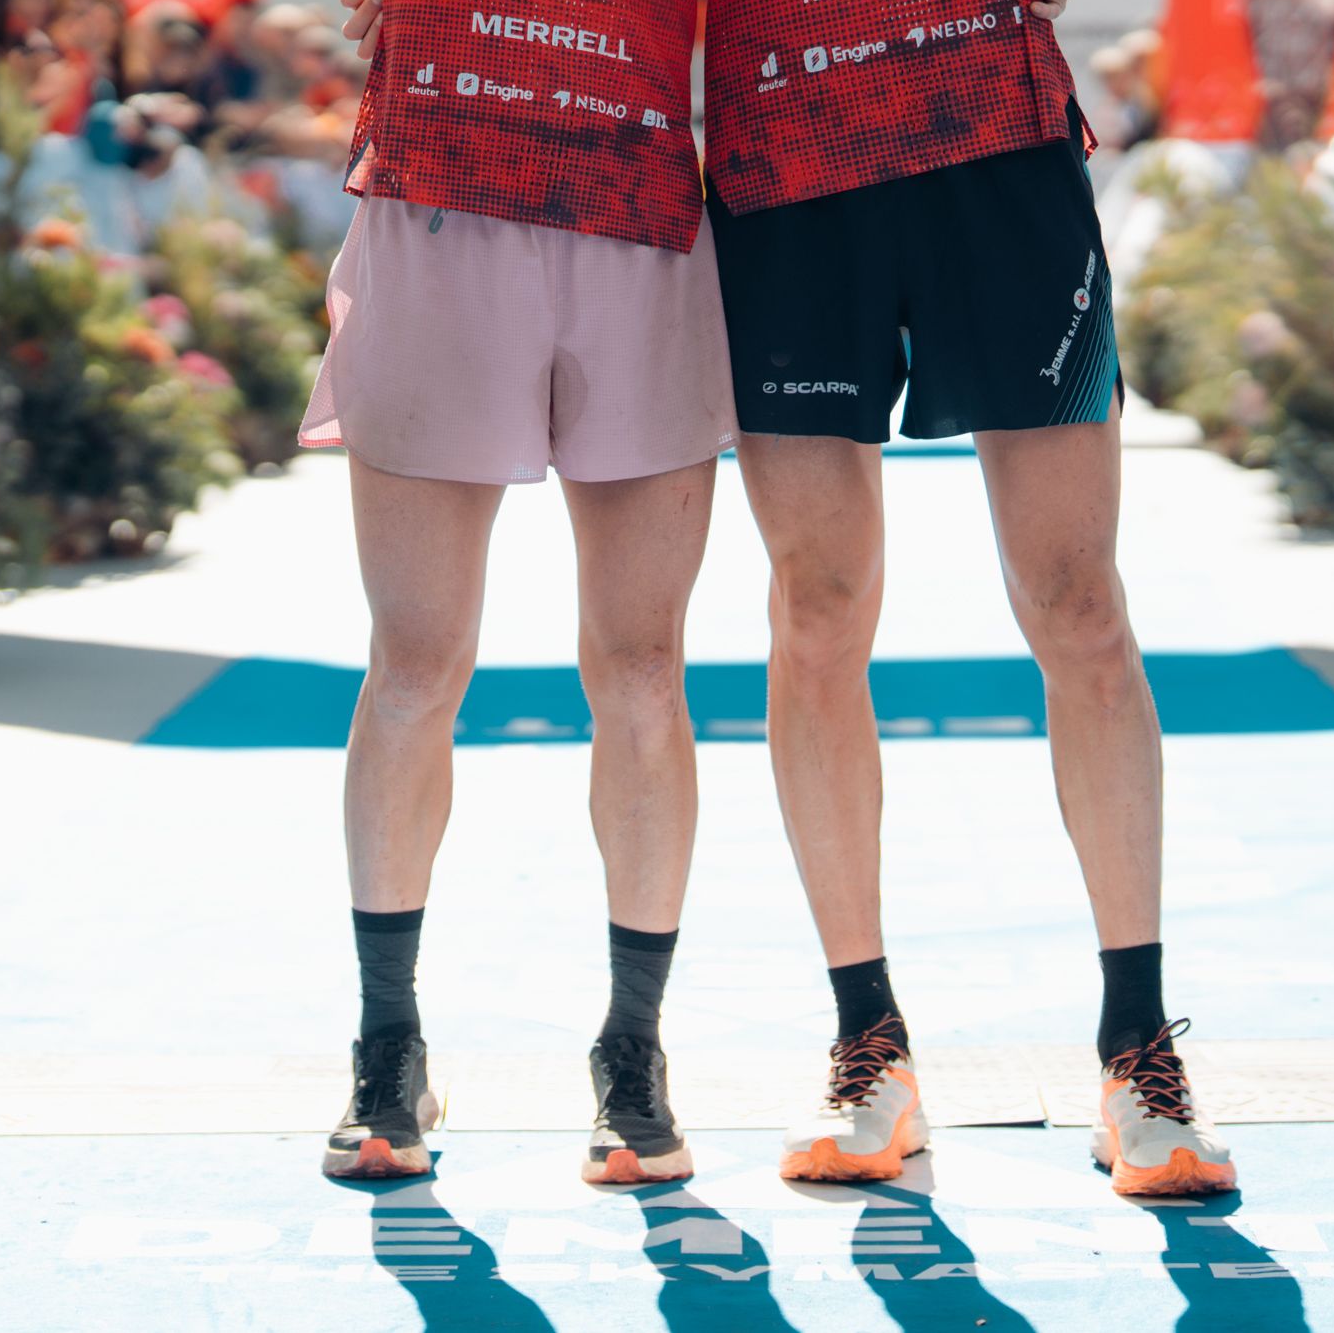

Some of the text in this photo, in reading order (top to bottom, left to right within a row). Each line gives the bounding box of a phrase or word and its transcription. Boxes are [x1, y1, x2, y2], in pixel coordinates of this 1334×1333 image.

[472, 12, 633, 62] MERRELL
[758, 77, 789, 93] deuter
[833, 40, 887, 64] Engine
[930, 13, 997, 41] NEDAO
[408, 85, 440, 98] deuter
[483, 80, 534, 102] Engine
[576, 95, 627, 120] NEDAO
[1068, 314, 1082, 337] s.r.l.
[783, 382, 858, 395] SCARPA
